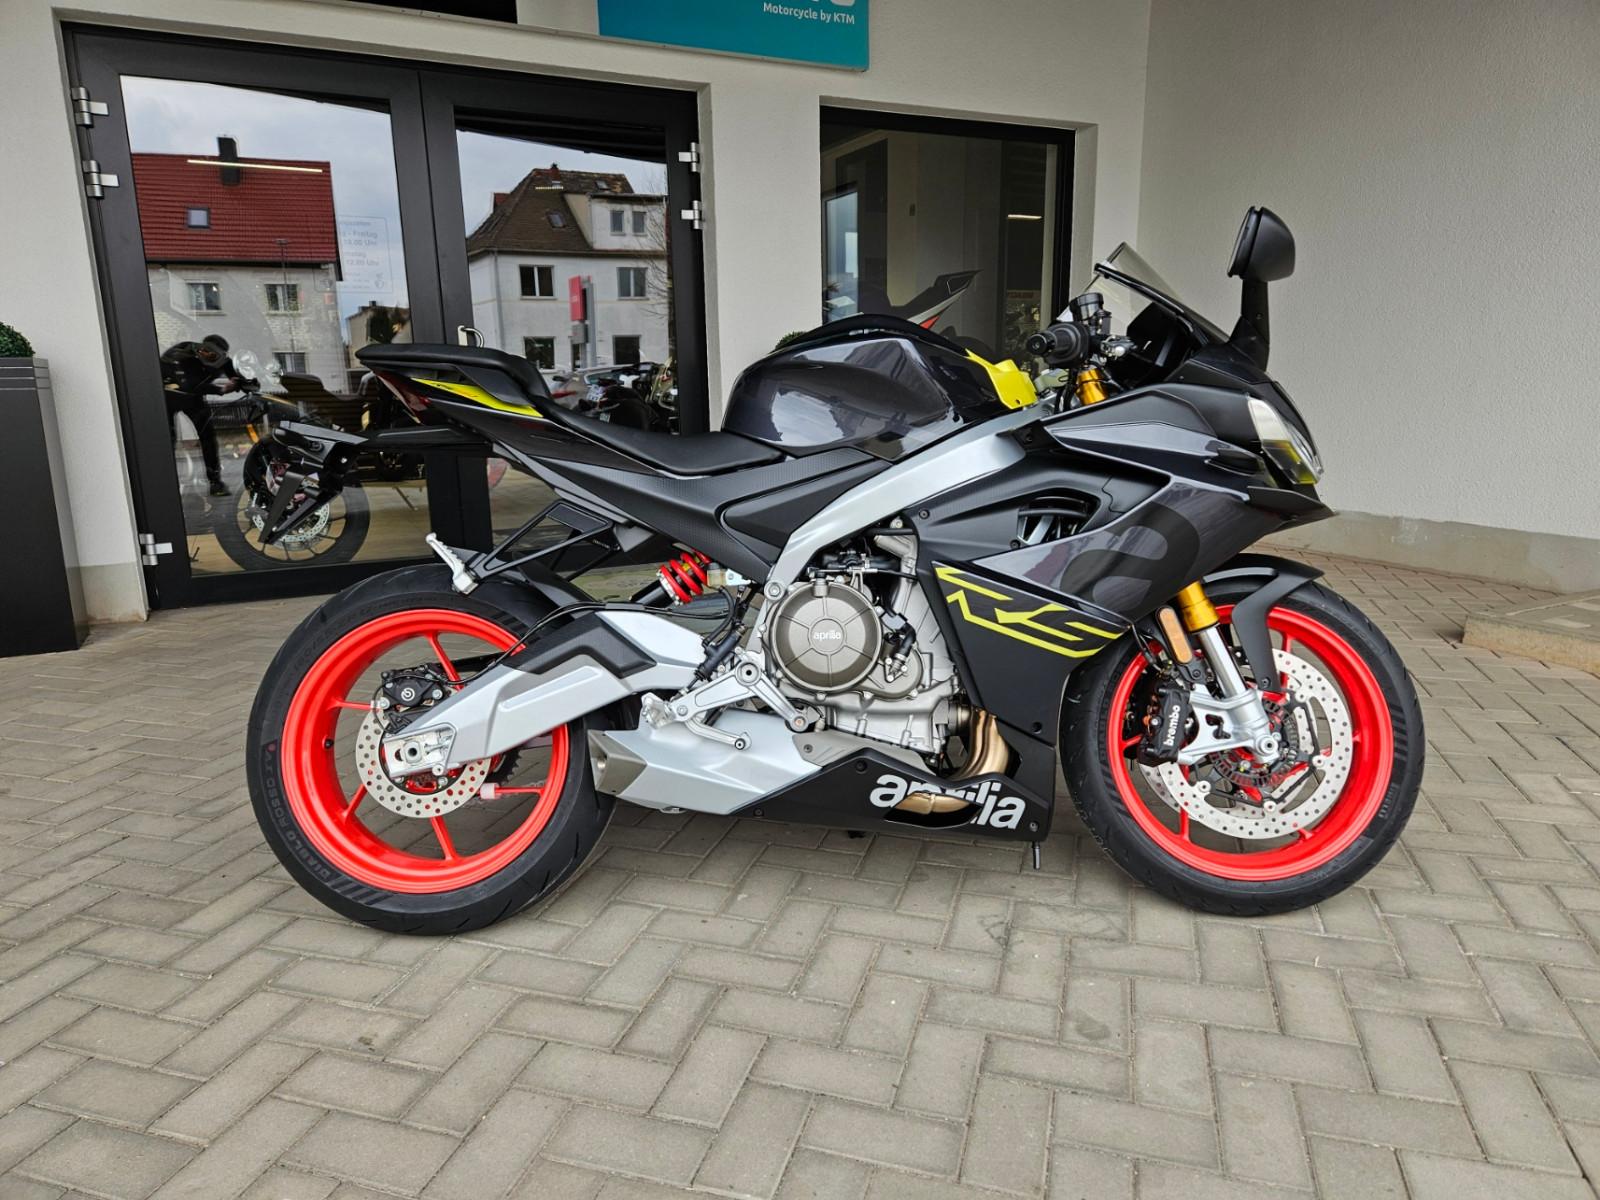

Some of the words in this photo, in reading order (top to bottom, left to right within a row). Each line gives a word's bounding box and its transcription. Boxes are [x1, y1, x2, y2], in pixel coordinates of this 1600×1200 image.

[763, 2, 818, 19] Motorcycle
[820, 10, 831, 23] by
[833, 12, 855, 24] KTM
[813, 629, 841, 641] aprilia
[1163, 704, 1181, 746] brembo
[266, 778, 289, 829] ROSSO
[286, 832, 332, 880] DIABLO
